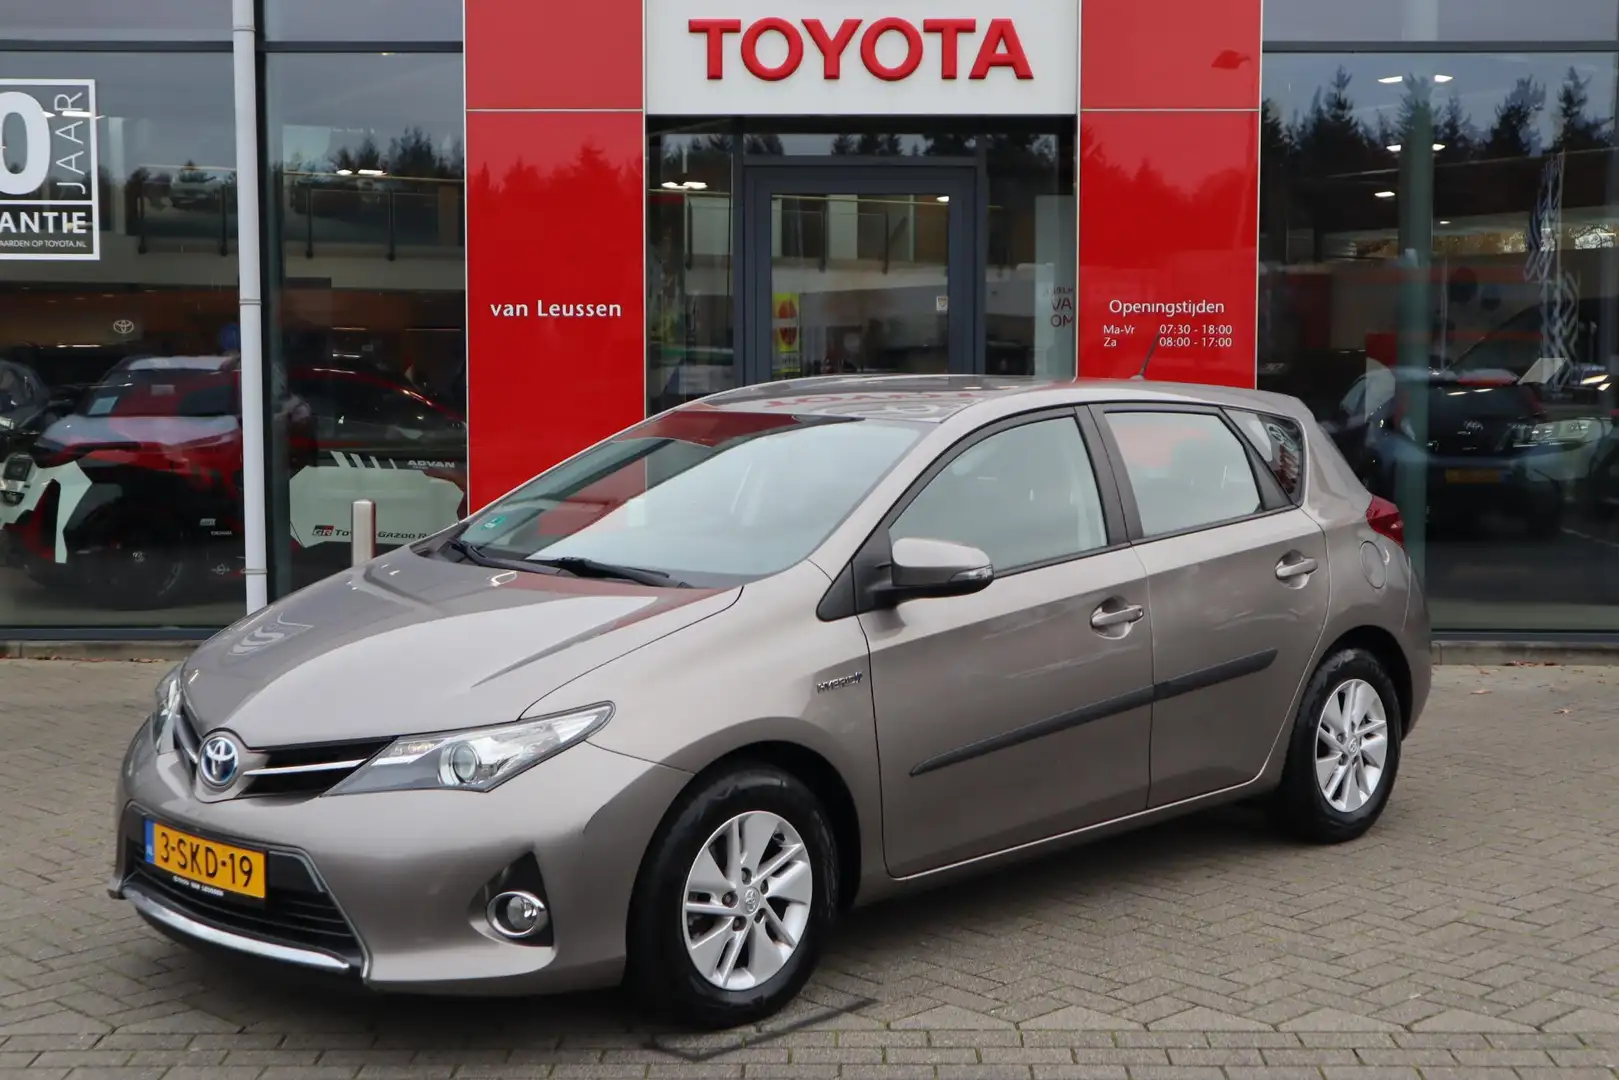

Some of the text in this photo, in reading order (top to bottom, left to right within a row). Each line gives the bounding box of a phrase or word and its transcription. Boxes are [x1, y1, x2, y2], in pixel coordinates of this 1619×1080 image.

[688, 17, 1033, 81] TOYOTA
[54, 92, 86, 195] JAAR
[32, 240, 43, 248] OP
[45, 240, 87, 248] TOYOTA.NL
[490, 299, 622, 317] van Leussen
[1109, 299, 1225, 318] Openingstijden
[1103, 324, 1135, 335] Ma-Vr
[1159, 324, 1191, 335] 07:30
[1202, 324, 1232, 335] 18:00
[1103, 337, 1117, 347] Za
[1159, 337, 1191, 347] 08:00
[1202, 337, 1232, 347] 17:00
[407, 459, 455, 468] ADVAN
